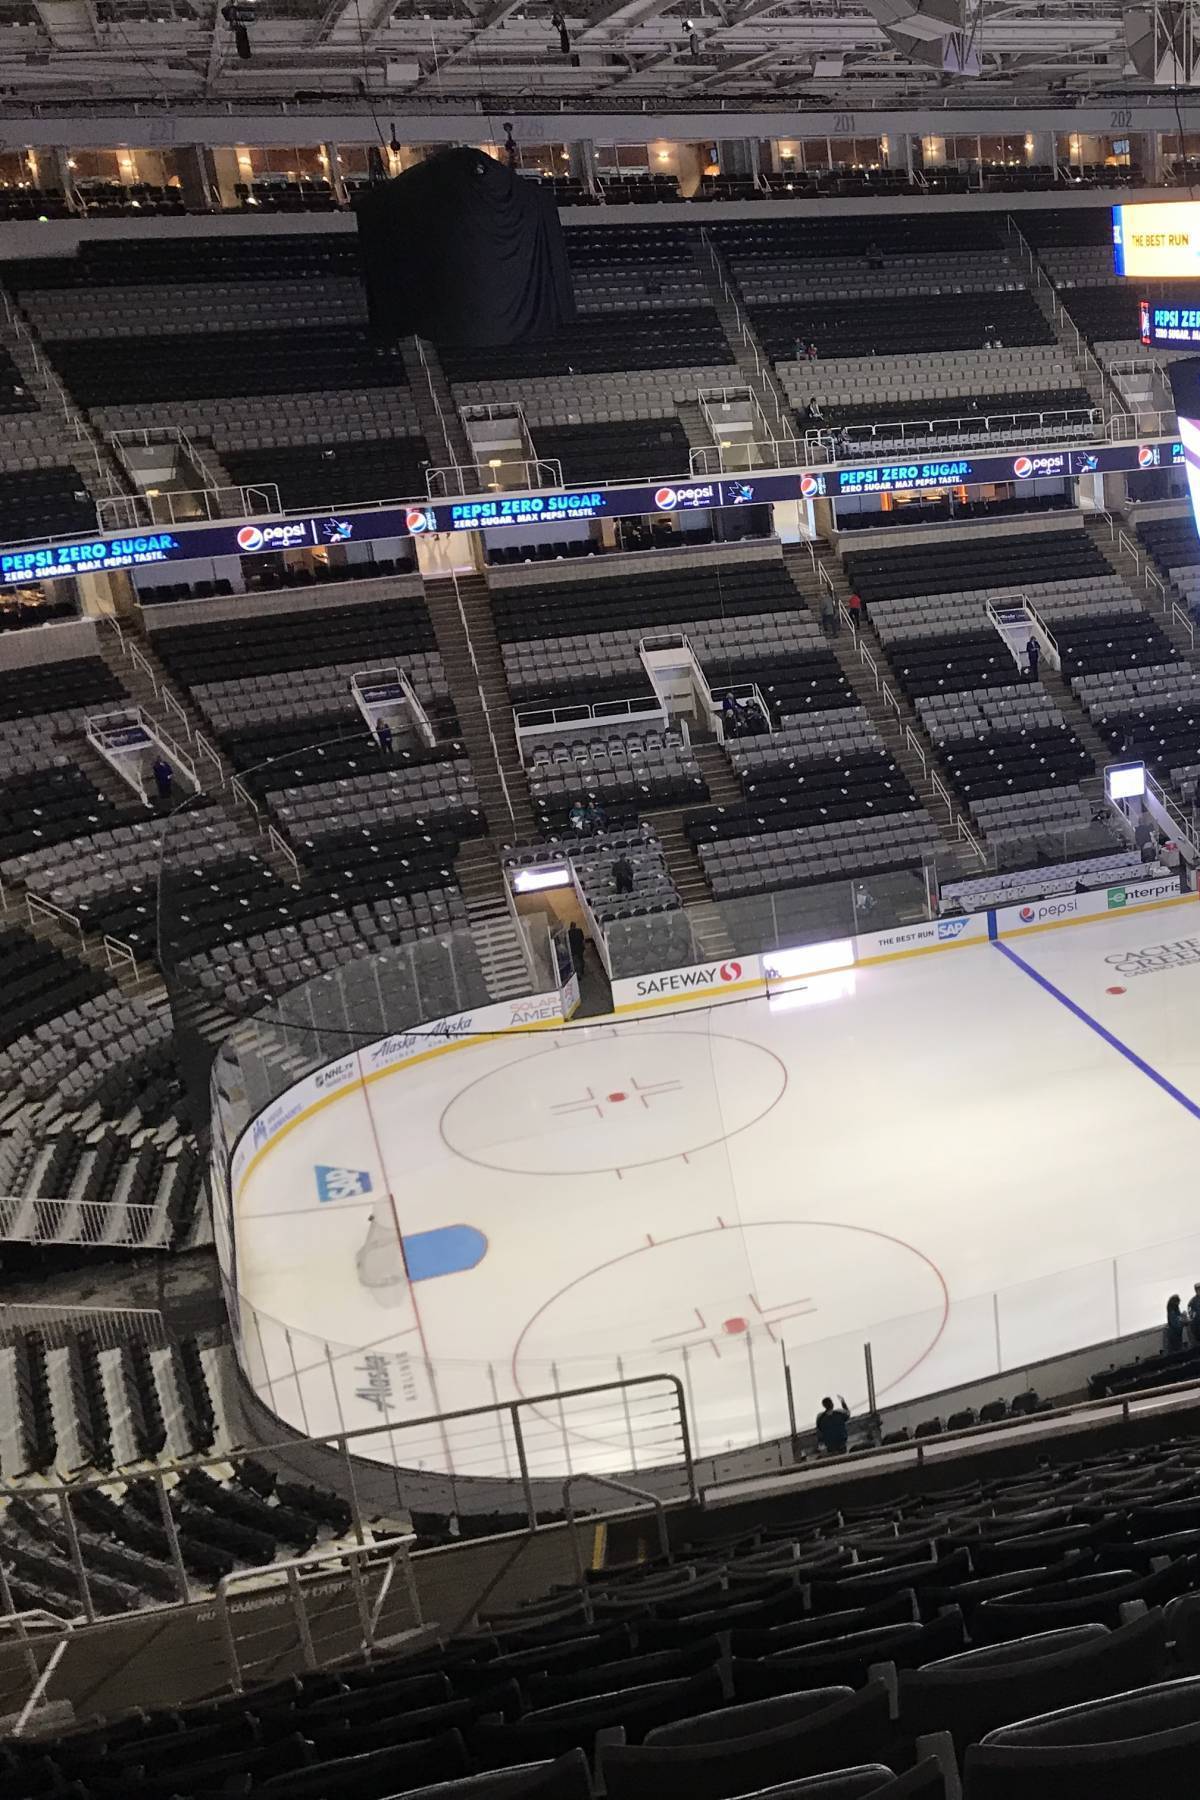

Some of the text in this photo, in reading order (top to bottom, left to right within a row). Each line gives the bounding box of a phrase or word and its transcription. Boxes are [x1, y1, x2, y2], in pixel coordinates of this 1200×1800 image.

[834, 114, 855, 132] 201
[1111, 111, 1132, 128] 202
[1132, 234, 1189, 247] THE BEST RUN
[1155, 310, 1178, 327] PEPSI
[1033, 455, 1064, 471] pepsi
[840, 462, 972, 485] PEPSI ZERO SUGAR.
[677, 485, 713, 502] pepsi
[841, 476, 962, 493] ZERO SUGAR. MAX PEPSI TASTE.
[452, 493, 606, 519] PEPSI ZERO SUGAR.
[454, 508, 596, 528] ZERO SUGAR. MAX PEPSI TASTE.
[263, 522, 306, 542] pepsi
[2, 535, 179, 571] PEPSI ZERO SUGAR.
[4, 551, 167, 581] ZERO SUGAR. MAX PEPSI TASTE.
[1113, 882, 1181, 902] enterpris
[1038, 899, 1077, 920] pepsi
[878, 921, 964, 946] THE BEST RUN SAP
[636, 968, 717, 996] SAFEWAY
[511, 997, 553, 1013] SOLAR
[424, 1017, 472, 1040] Alaska
[372, 1036, 417, 1061] Alaska
[325, 1169, 364, 1201] SAP
[354, 1355, 396, 1412] Alaska
